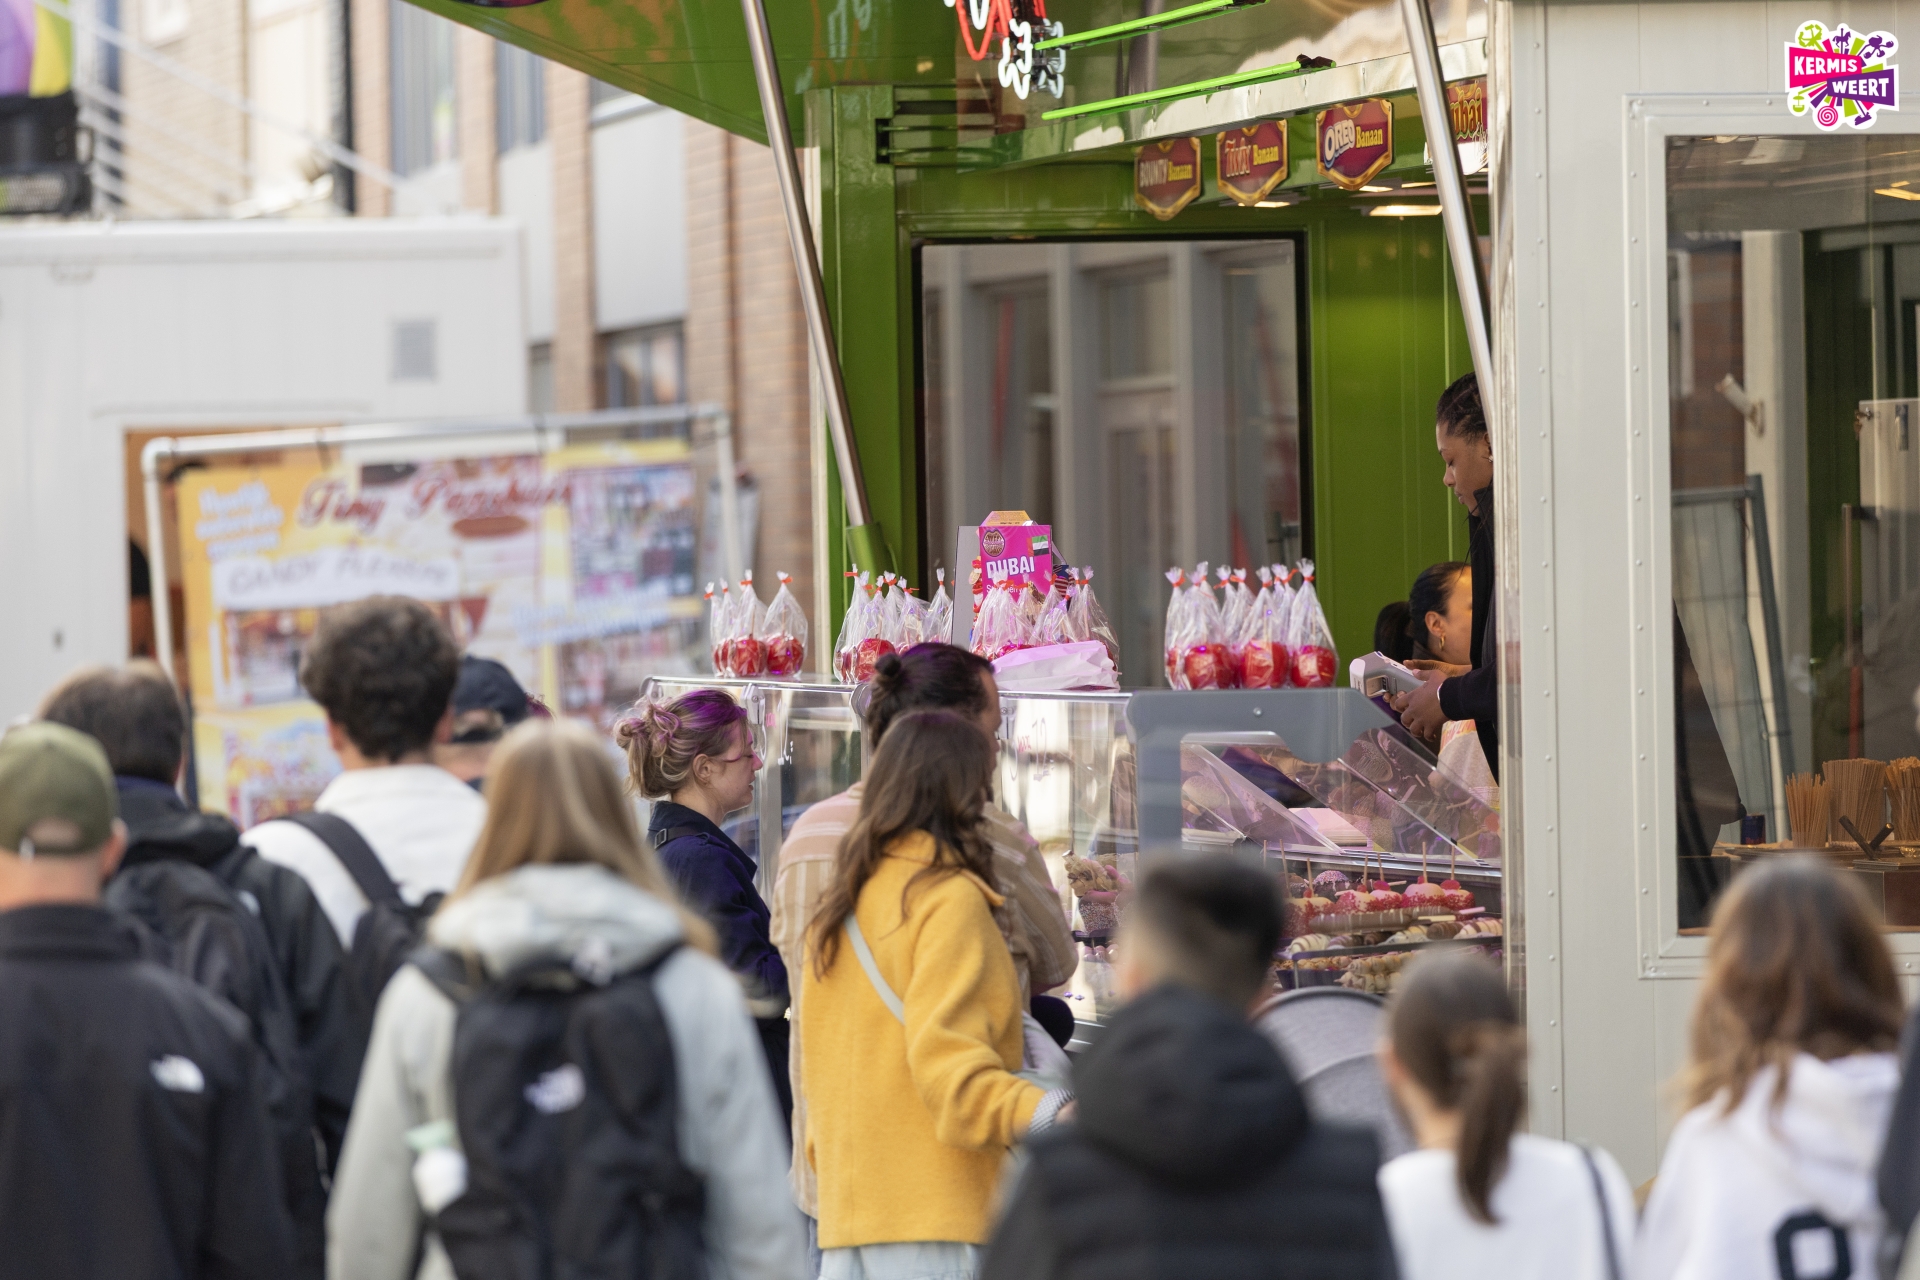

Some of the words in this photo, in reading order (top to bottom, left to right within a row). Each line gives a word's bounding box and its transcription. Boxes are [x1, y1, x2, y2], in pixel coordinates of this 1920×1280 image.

[1450, 87, 1483, 140] ubai
[1252, 144, 1280, 166] Banaan
[1324, 119, 1356, 163] OREO
[1355, 125, 1383, 149] Banaan
[1139, 158, 1168, 188] BOUNTY
[1167, 161, 1193, 182] Banaan
[986, 555, 1035, 580] DUBAI
